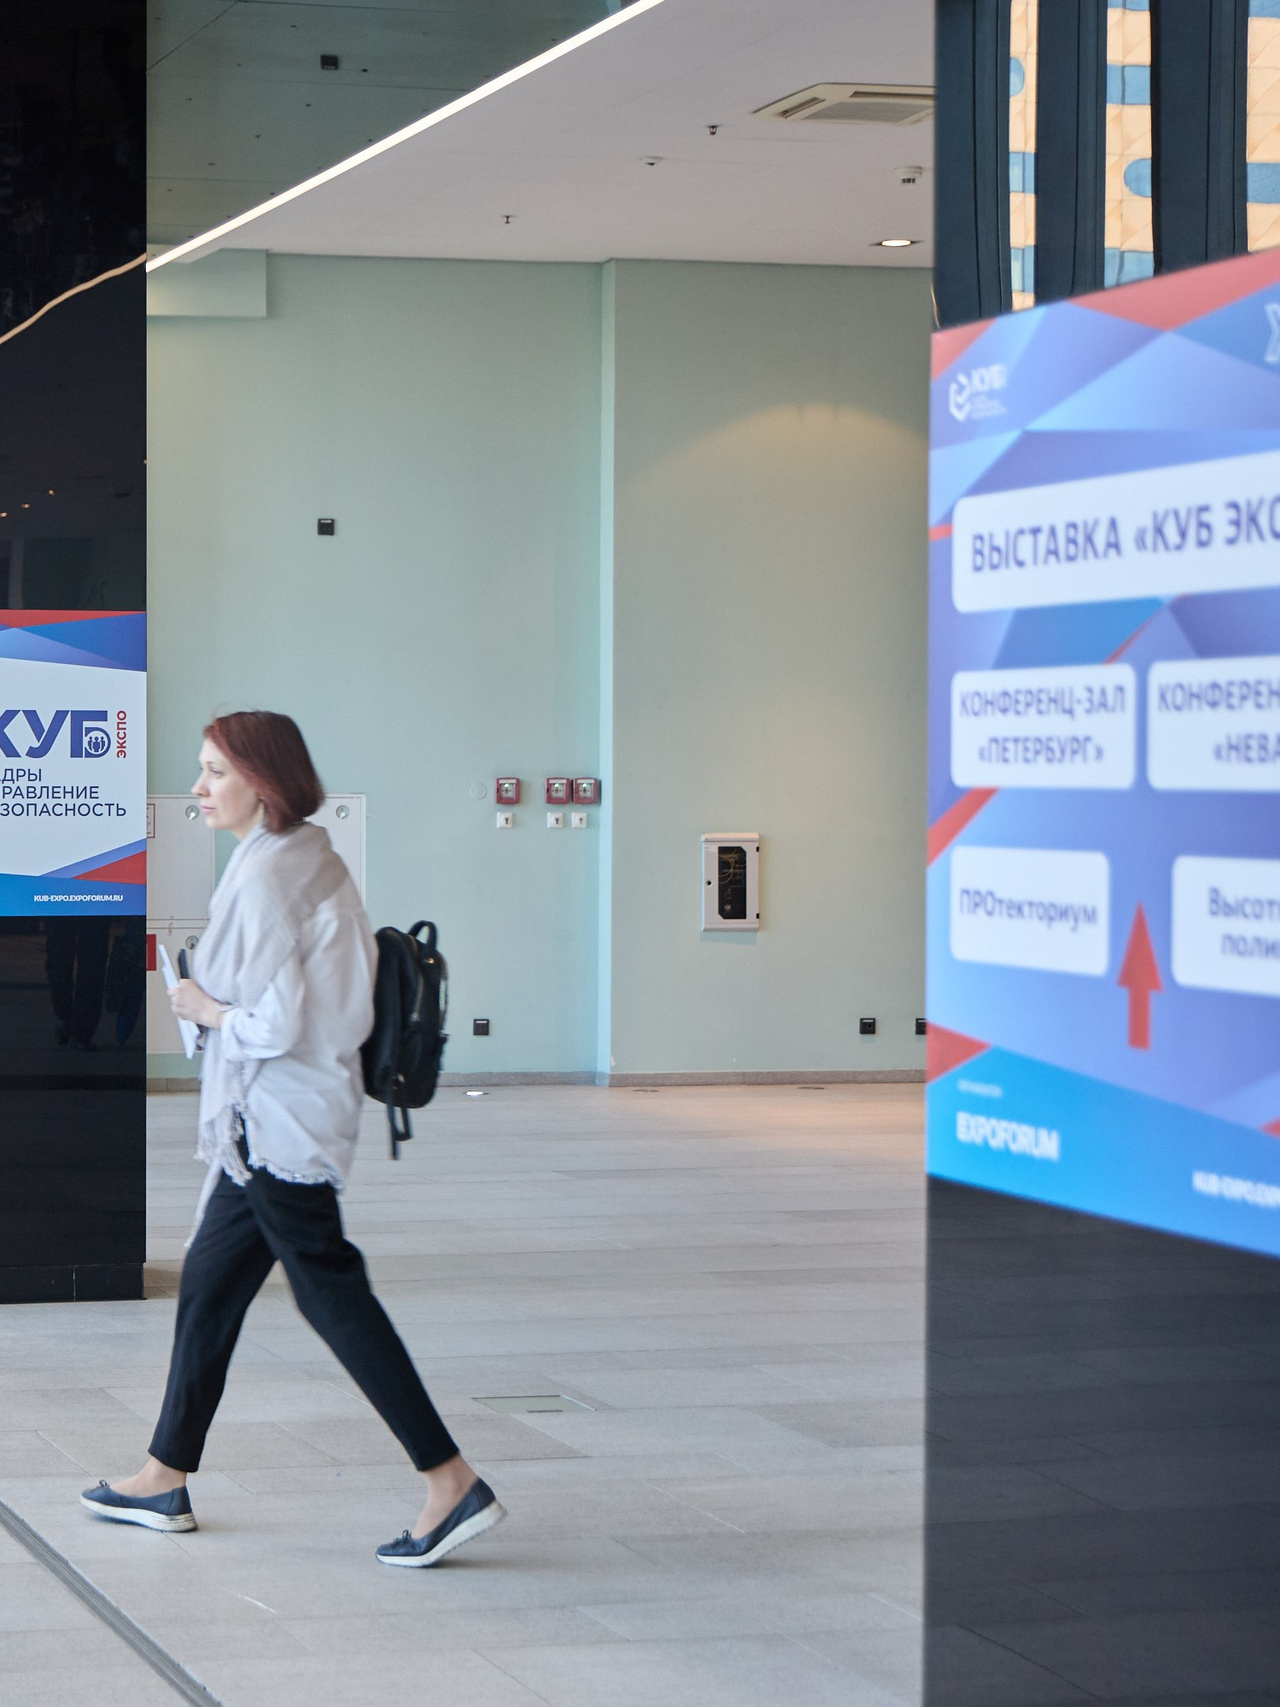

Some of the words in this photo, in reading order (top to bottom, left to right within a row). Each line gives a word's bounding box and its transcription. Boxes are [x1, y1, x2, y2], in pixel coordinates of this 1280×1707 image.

[972, 516, 1123, 573] ВЫСТАВКА
[1134, 503, 1213, 553] «КУБ
[959, 684, 1126, 719] КОНФЕРЕНЦ-ЗАЛ
[116, 710, 127, 758] ЭКСПО
[978, 735, 1103, 764] «ПЕТЕРБУРГ»
[34, 894, 124, 902] KUB-EXPO.EXPOFORUM.RU
[959, 888, 1098, 932] ПРОтекториум
[1209, 886, 1280, 919] Высот
[956, 1110, 1060, 1161] EXPOFORUM
